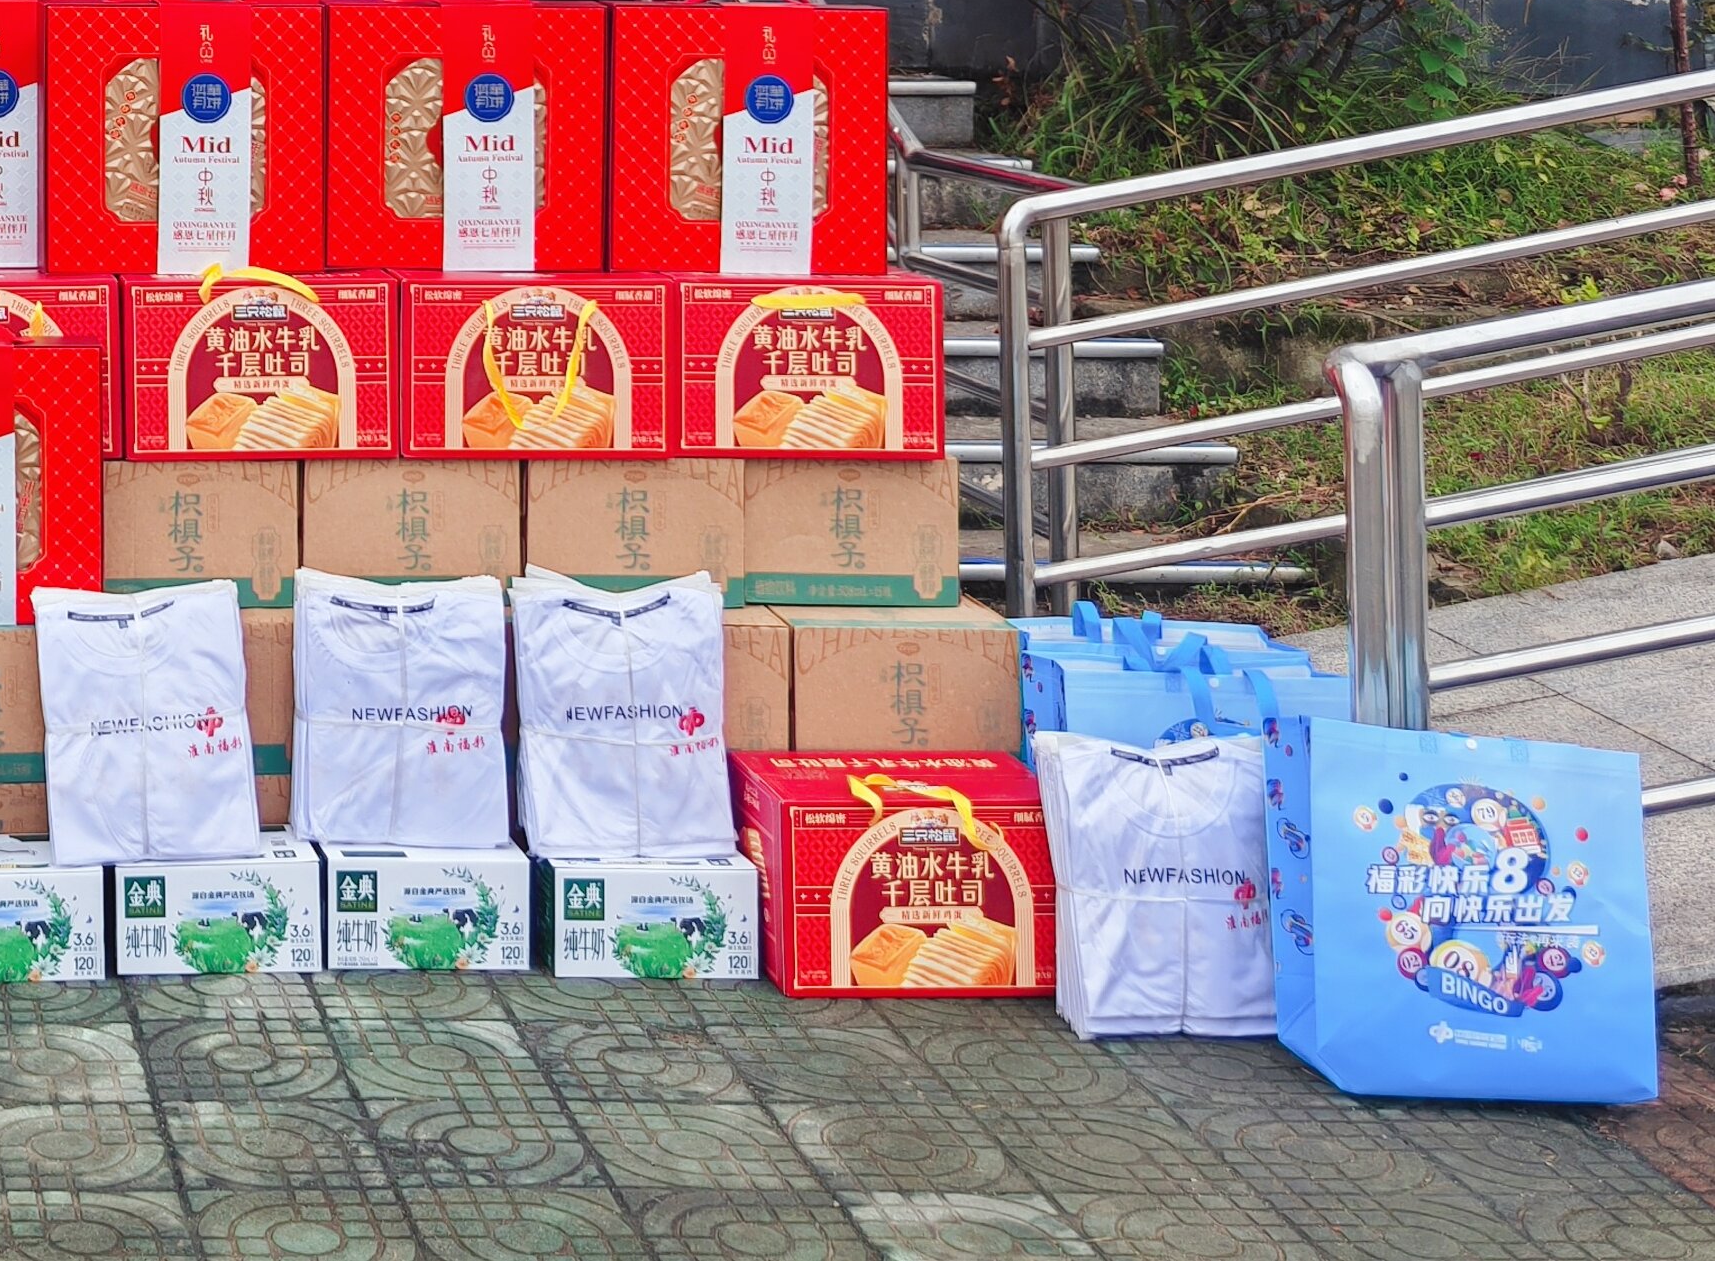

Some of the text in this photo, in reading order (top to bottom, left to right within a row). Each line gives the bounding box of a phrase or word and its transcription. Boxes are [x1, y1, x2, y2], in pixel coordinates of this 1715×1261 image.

[180, 135, 230, 153] Mid
[464, 134, 513, 152] Mid
[743, 136, 792, 154] Mid
[197, 167, 213, 205] 中秋
[481, 165, 497, 203] 中秋
[759, 167, 775, 205] 中秋
[234, 306, 286, 318] 三只松鼠
[511, 306, 564, 318] 三只松鼠
[206, 326, 320, 352] 黄油水牛乳
[752, 325, 867, 351] 黄油水牛乳
[216, 352, 309, 377] 千层吐司
[763, 351, 857, 376] 千层吐司
[352, 705, 474, 721] NEWFASHION
[566, 705, 683, 723] NEWFASHION
[1477, 806, 1496, 820] 79
[900, 829, 958, 843] 三只松鼠
[869, 851, 995, 880] 黄油水牛乳
[1124, 867, 1245, 885] NEWFASHION
[1367, 847, 1530, 896] 福彩快乐8
[127, 881, 163, 907] 金典
[339, 876, 375, 902] 金典
[566, 884, 602, 910] 金典
[881, 879, 984, 907] 千层吐司
[1420, 894, 1576, 924] 向快乐出发
[125, 925, 166, 958] 纯牛奶
[336, 919, 377, 952] 纯牛奶
[728, 930, 748, 944] 3.6
[1395, 919, 1419, 941] 65
[563, 927, 604, 960] 纯牛奶
[728, 956, 748, 969] 120
[1403, 952, 1420, 969] 02
[1441, 972, 1508, 1015] BINGO
